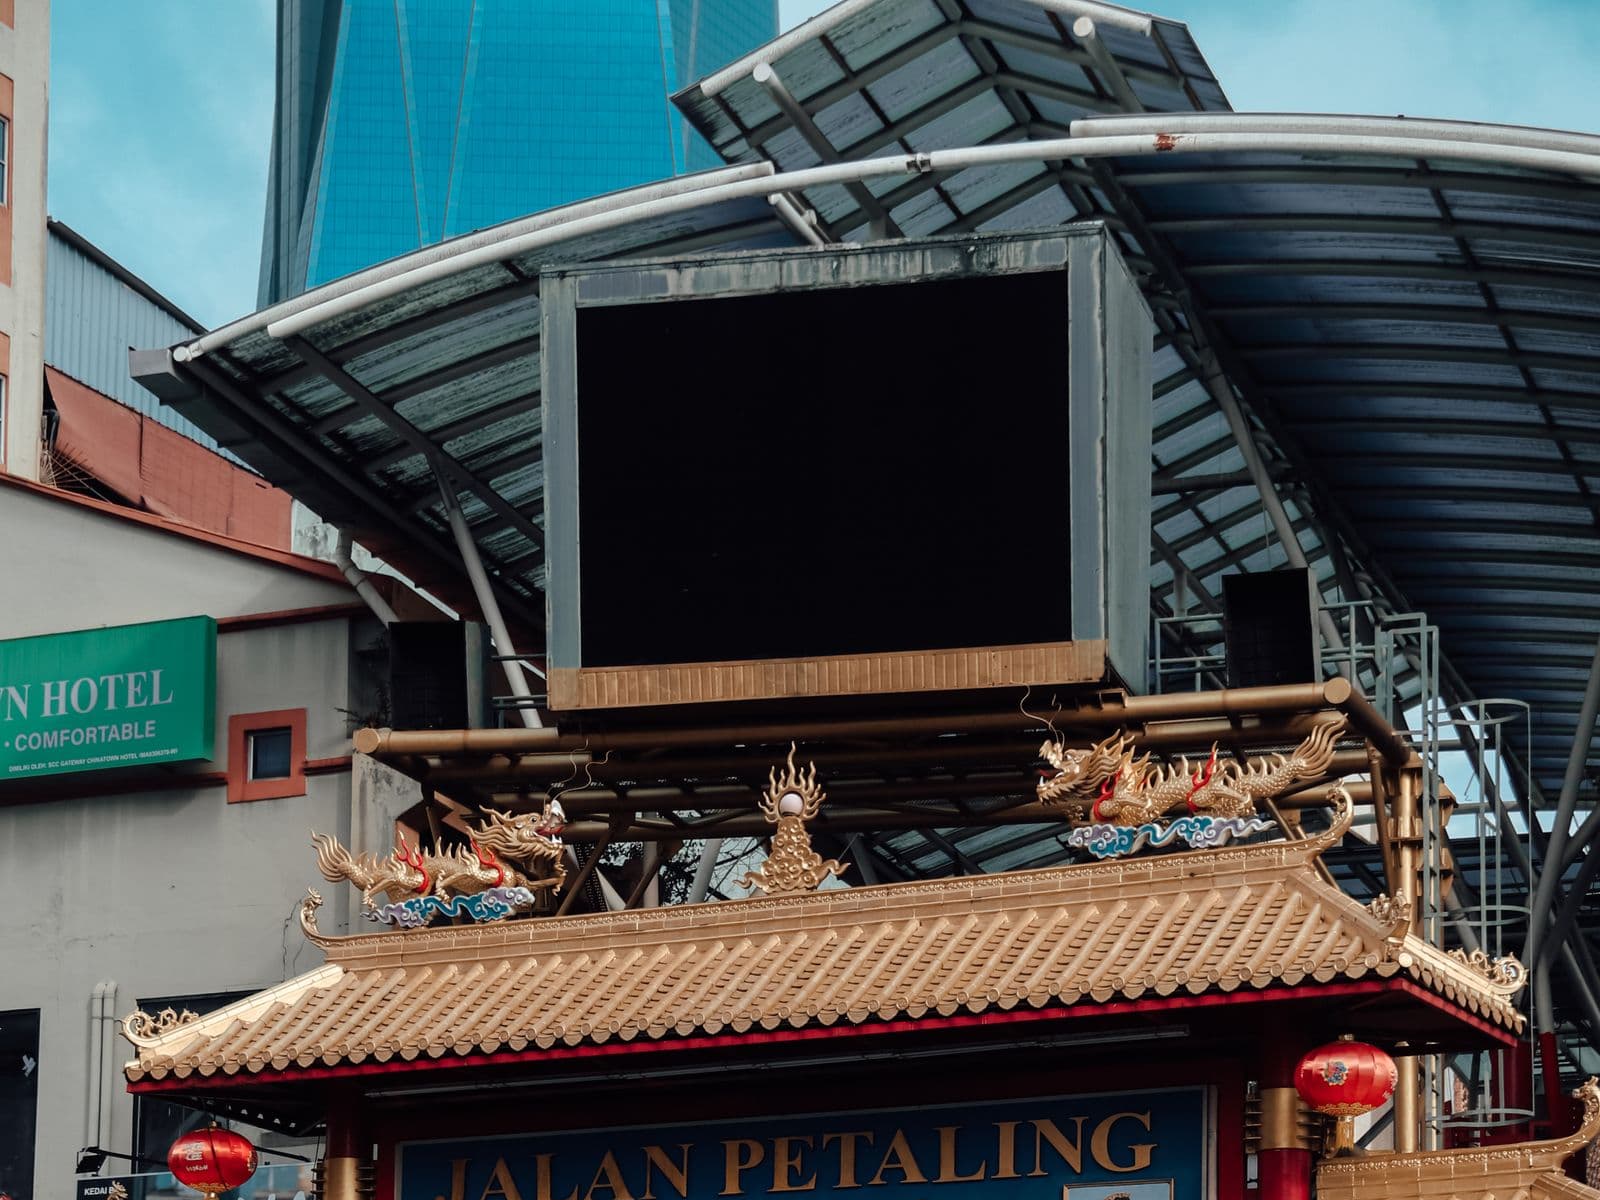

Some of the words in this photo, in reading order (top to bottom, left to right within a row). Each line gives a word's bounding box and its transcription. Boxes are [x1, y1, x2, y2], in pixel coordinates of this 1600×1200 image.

[41, 670, 174, 718] HOTEL
[15, 720, 156, 752] COMFORTABLE
[718, 1110, 1158, 1197] PETALING
[84, 1187, 108, 1197] KEDAI
